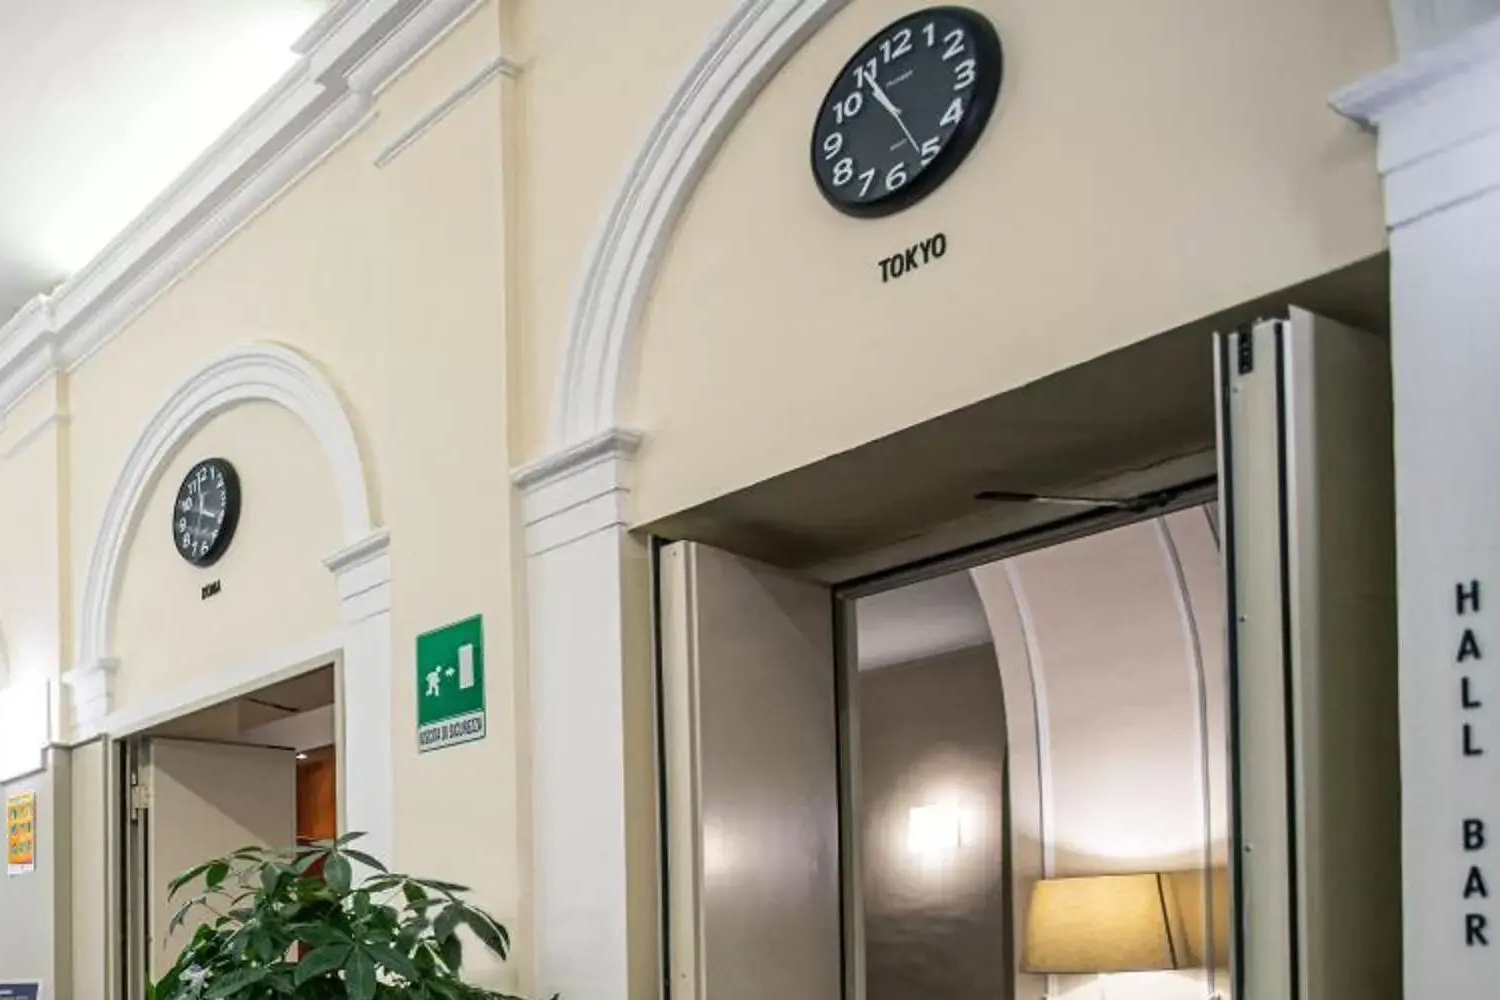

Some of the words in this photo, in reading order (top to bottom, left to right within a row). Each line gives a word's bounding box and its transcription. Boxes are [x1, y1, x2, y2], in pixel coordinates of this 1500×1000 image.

[879, 28, 913, 63] 12
[922, 22, 934, 47] 1
[942, 29, 965, 61] 2
[853, 57, 877, 88] 11
[953, 58, 976, 91] 3
[832, 91, 863, 124] 10
[939, 97, 965, 127] 4
[823, 132, 843, 160] 9
[920, 136, 941, 167] 5
[832, 157, 853, 187] 8
[858, 167, 875, 197] 7
[885, 162, 907, 192] 6
[878, 232, 947, 283] TOKYO
[188, 479, 197, 495] 11
[210, 465, 215, 480] 1
[180, 517, 187, 533] 9
[183, 532, 191, 549] 8
[200, 541, 209, 556] 6
[1455, 579, 1483, 757] HALL
[1462, 818, 1489, 947] BAR
